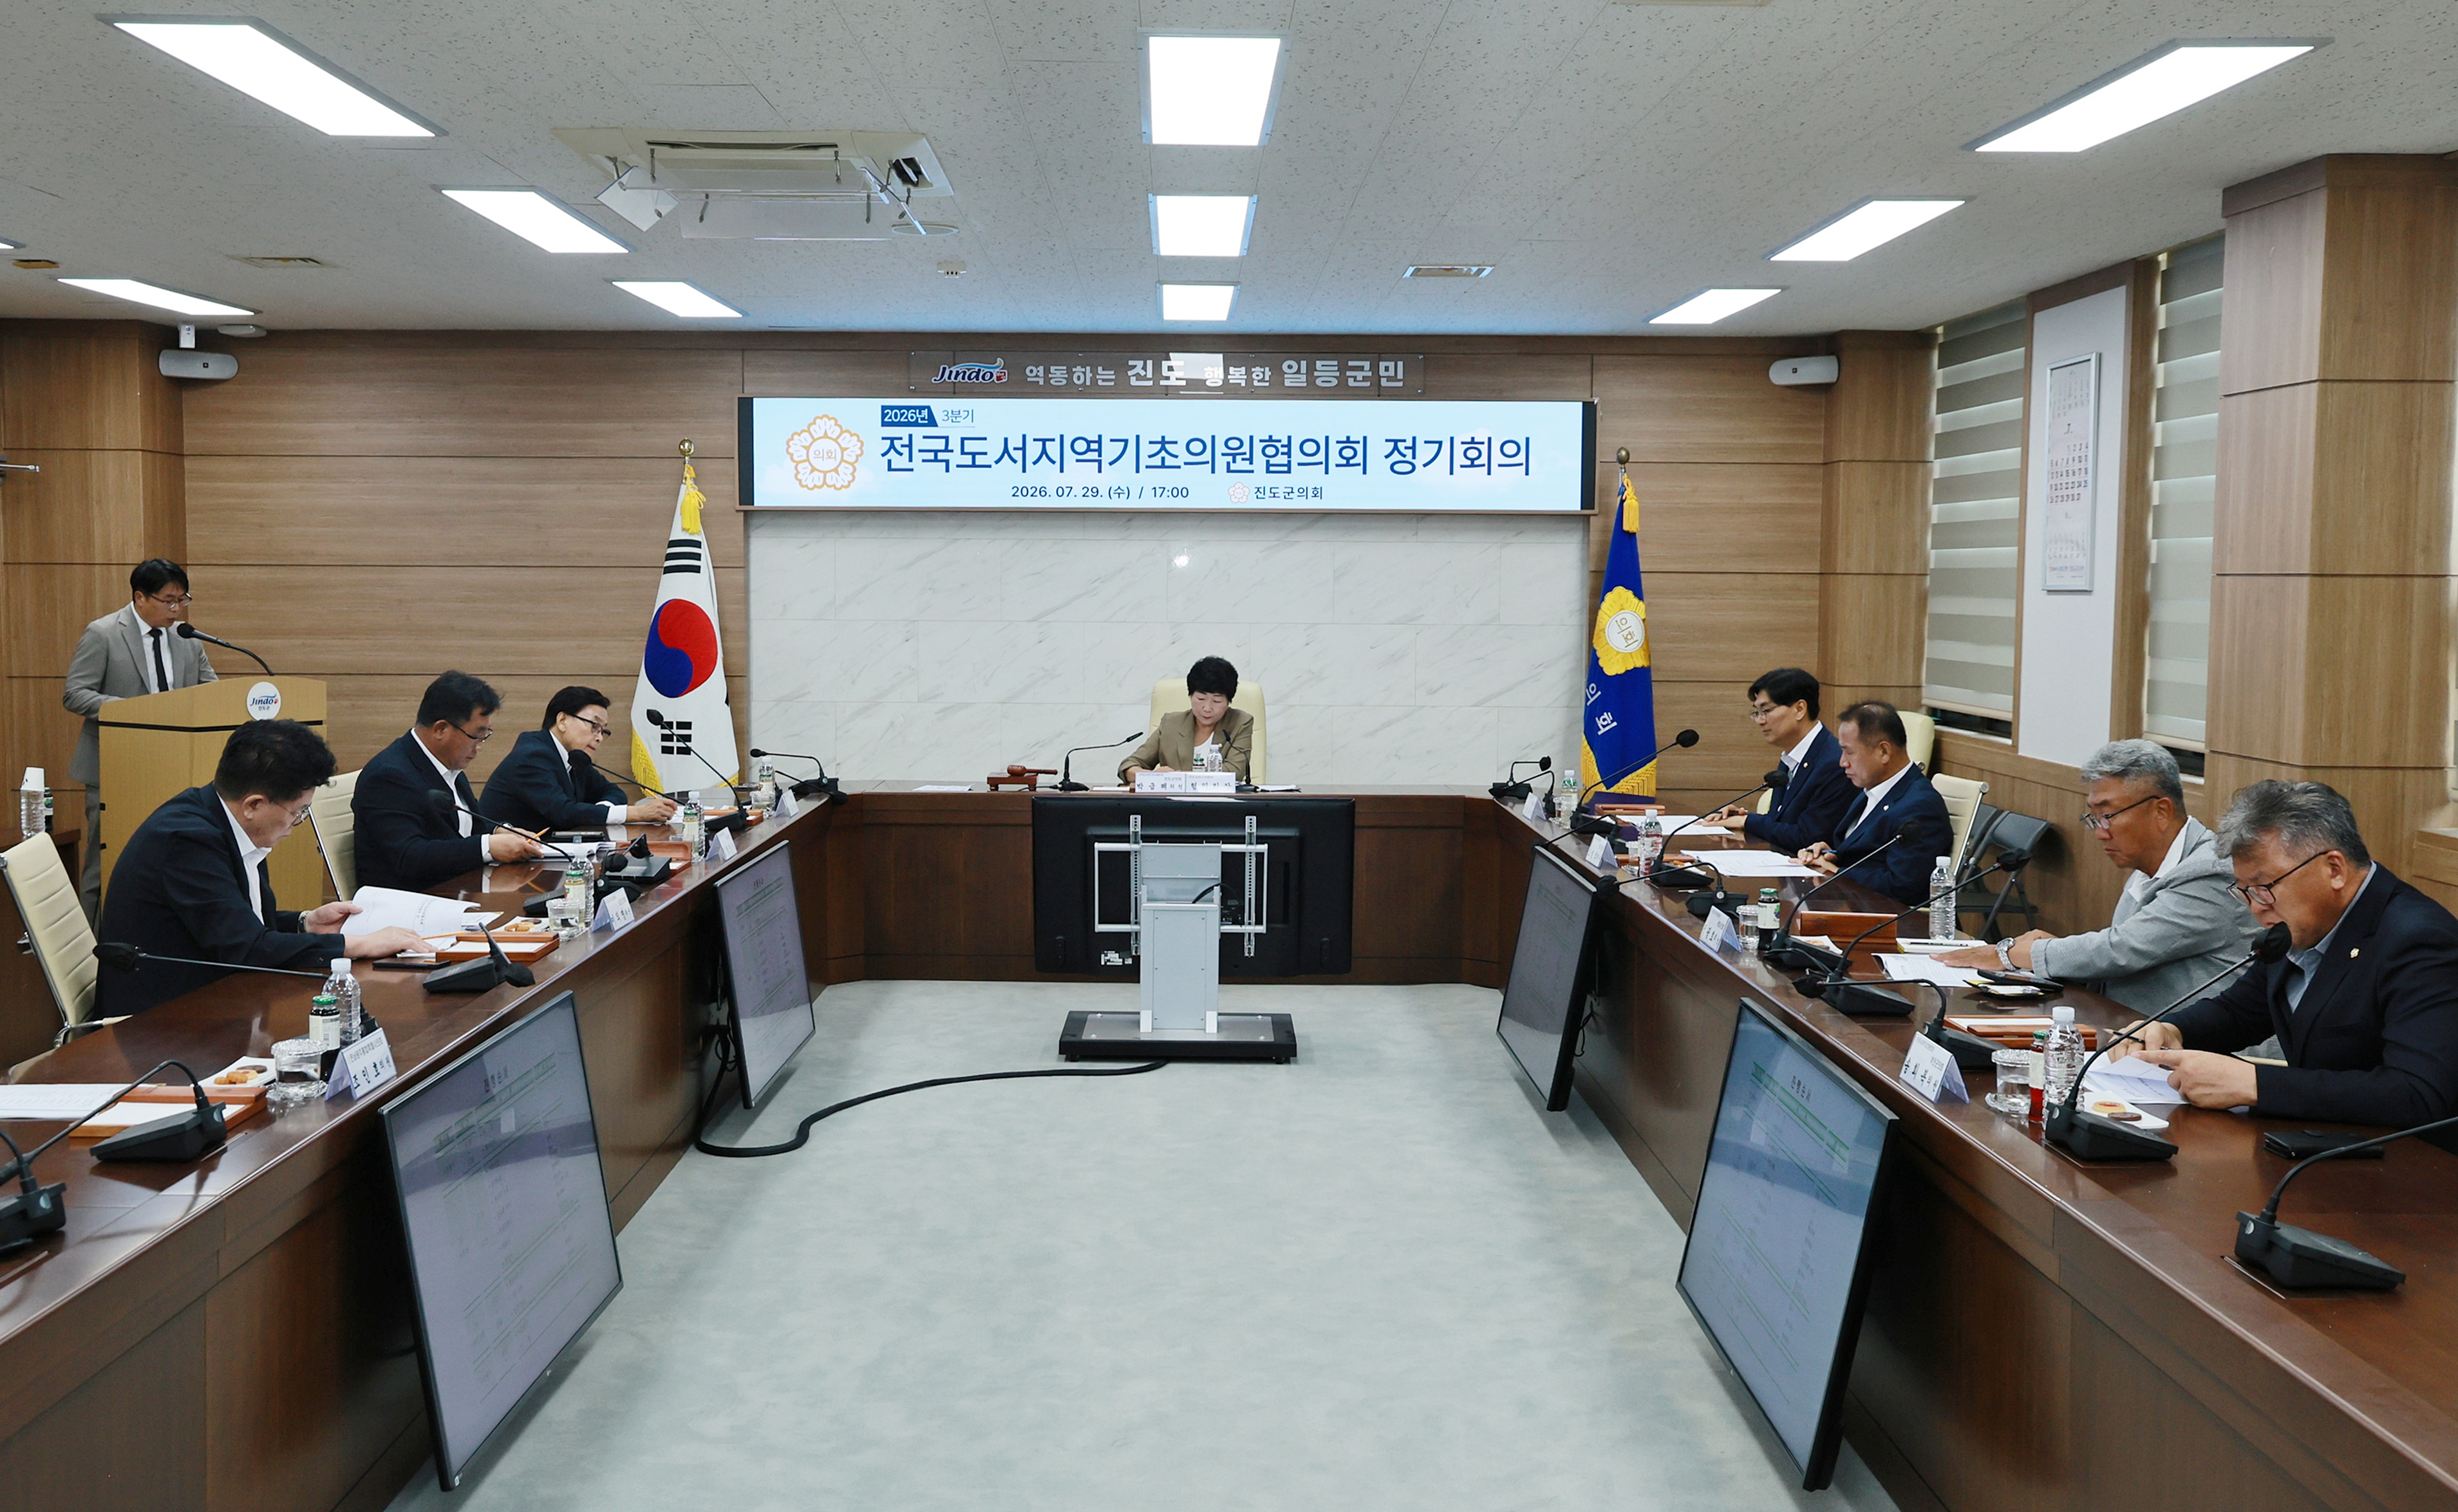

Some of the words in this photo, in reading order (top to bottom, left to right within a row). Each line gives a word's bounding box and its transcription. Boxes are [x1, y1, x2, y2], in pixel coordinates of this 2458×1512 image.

[932, 364, 995, 383] Jindo
[1026, 365, 1115, 386] 역동하는
[1127, 359, 1187, 386] 진도
[1203, 366, 1271, 387] 행복한
[1282, 360, 1403, 387] 일등군민
[884, 408, 928, 424] 2026년
[941, 409, 974, 424] 3분기
[812, 448, 837, 462] 의회
[880, 433, 1367, 475] 전국도서지역기초의원협의회
[1384, 436, 1530, 476] 정기회의
[1011, 485, 1052, 498] 2026.
[1056, 485, 1078, 498] 07.
[1082, 485, 1103, 498] 29.
[1108, 485, 1130, 500] (수)
[1152, 487, 1189, 498] 17:00
[1254, 486, 1323, 500] 진도군의회
[1615, 617, 1639, 648] 의회
[250, 697, 274, 706] Jindo
